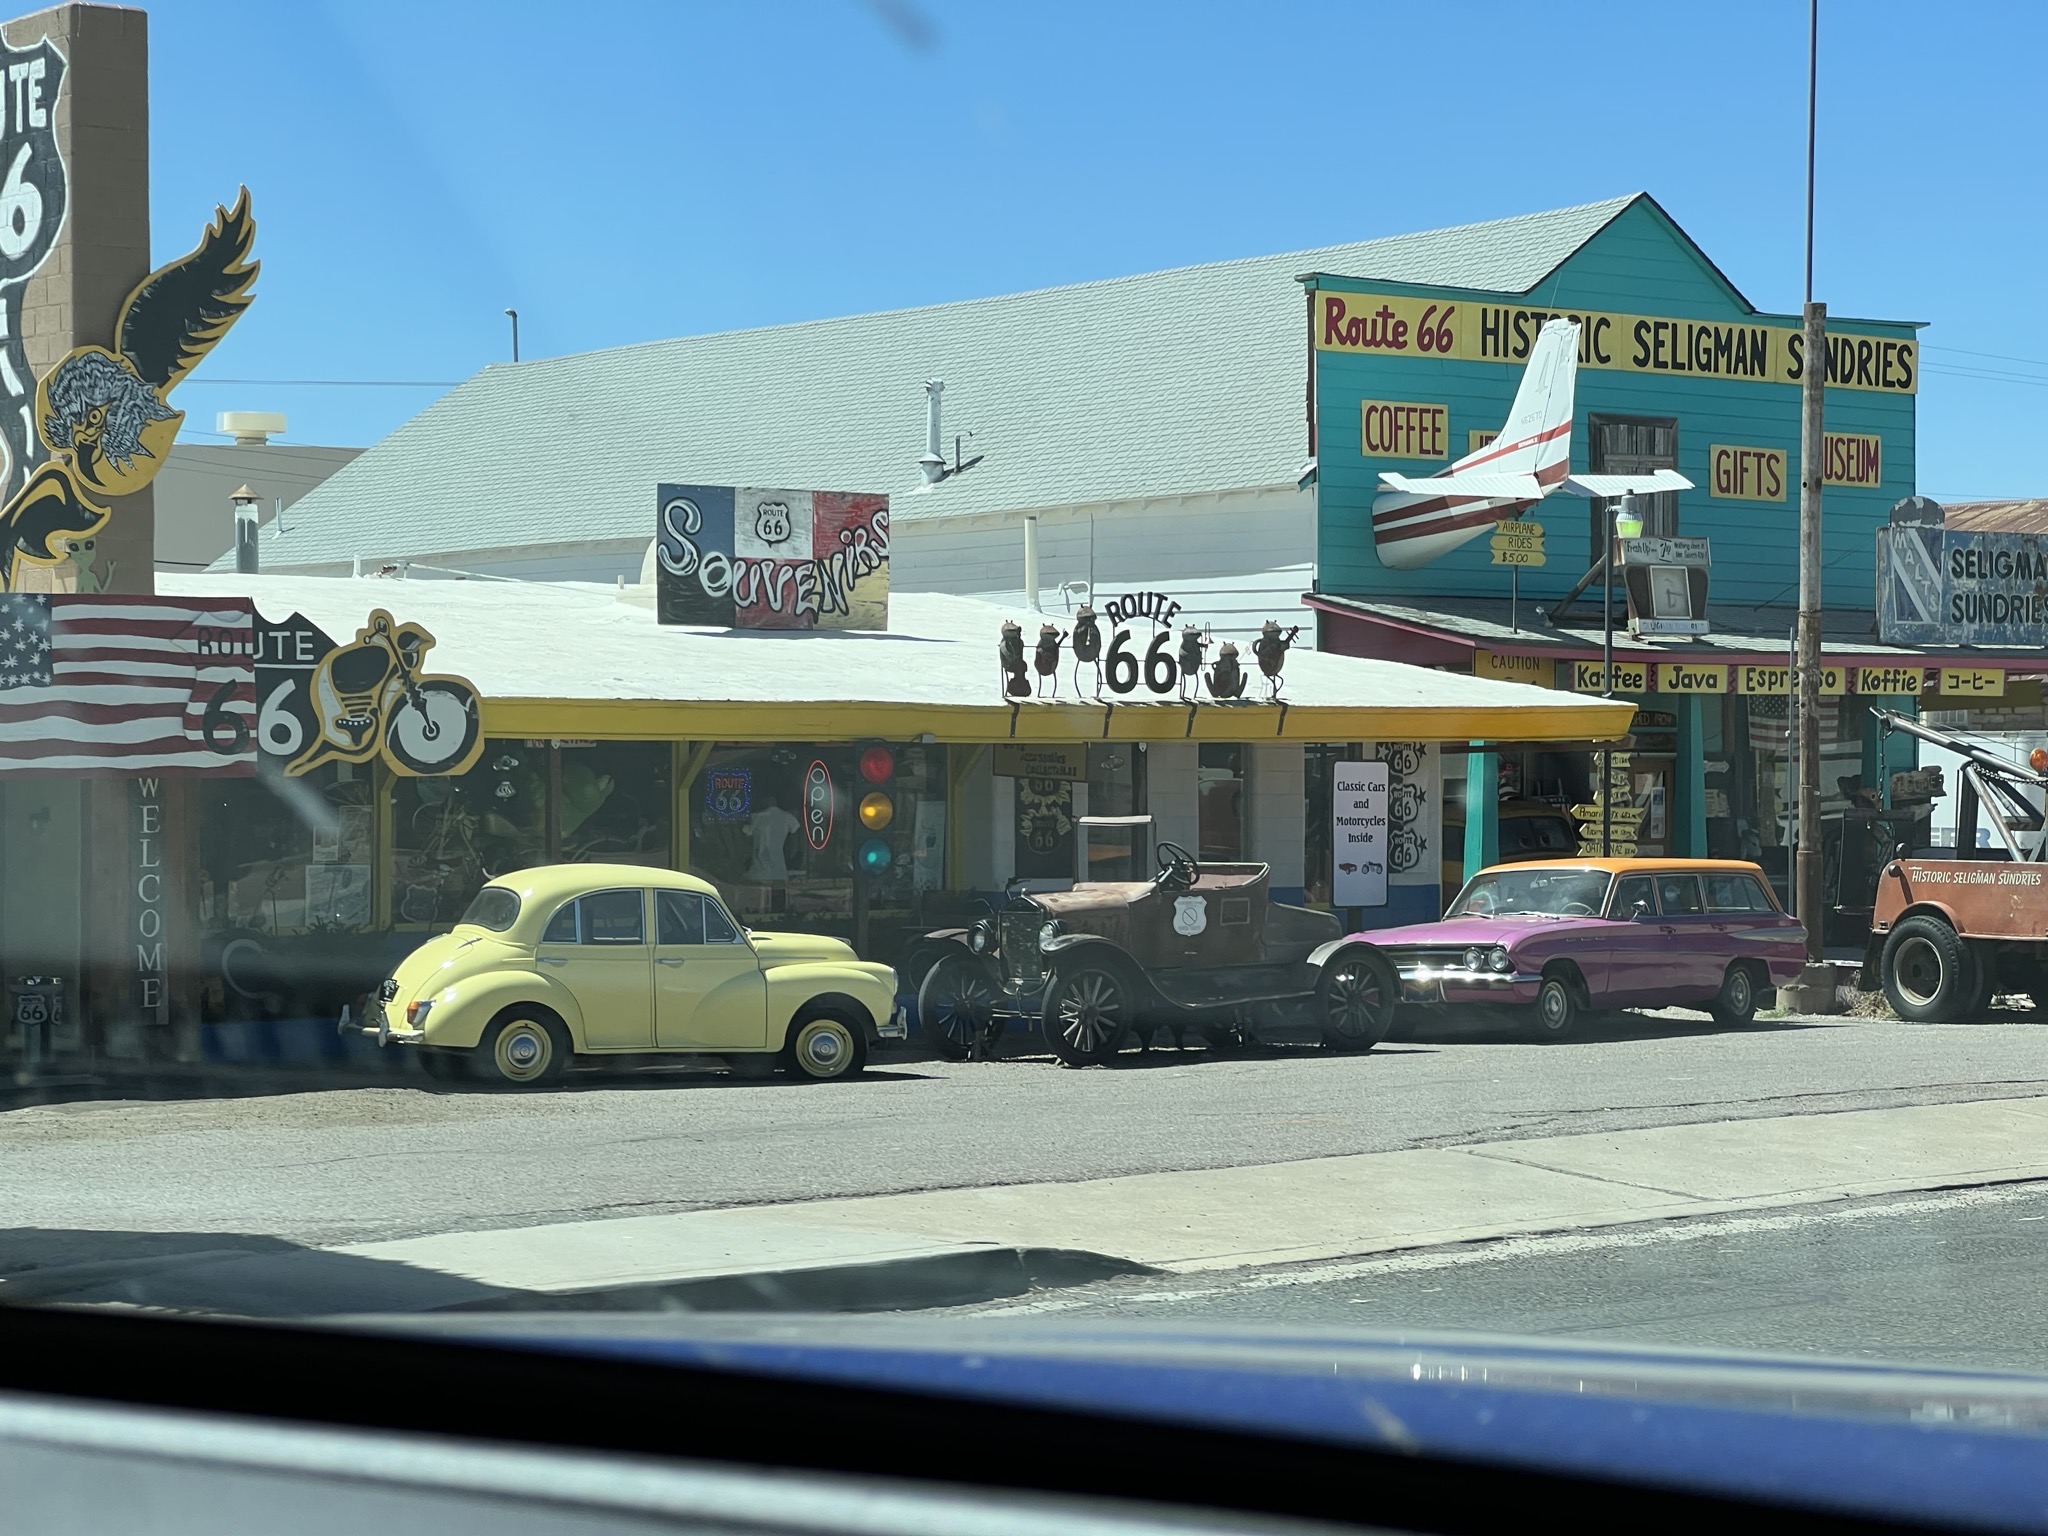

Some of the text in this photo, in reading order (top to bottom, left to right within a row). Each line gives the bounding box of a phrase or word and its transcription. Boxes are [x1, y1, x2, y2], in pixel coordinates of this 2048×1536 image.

[1324, 297, 1409, 350] Route
[1416, 305, 1455, 353] 66
[1632, 319, 1767, 377] SELIGMAN
[1786, 333, 1912, 389] SNDRIES
[1365, 404, 1444, 456] COFFEE
[1822, 436, 1879, 484] USEUM
[1716, 449, 1781, 497] GIFTS
[763, 508, 784, 517] ROUTE
[763, 519, 783, 535] 66
[1502, 521, 1536, 535] AIRPLANE
[1508, 537, 1533, 549] RIDES
[1105, 592, 1181, 629] ROUTE
[197, 627, 315, 661] ROUTE
[1105, 629, 1177, 694] 66
[1491, 655, 1540, 670] CAUTION
[1668, 665, 1718, 689] Java
[1861, 668, 1918, 692] Koffie
[1948, 671, 1996, 691] コーヒー
[202, 678, 304, 756] 66
[1394, 753, 1412, 770] 66
[714, 777, 745, 790] ROUTE
[1337, 781, 1386, 792] Classic Cars
[715, 789, 742, 811] 66
[1393, 790, 1412, 799] ROUTE
[1353, 799, 1369, 809] and
[1394, 800, 1412, 817] 66
[1336, 815, 1386, 828] Motorcycles
[1348, 833, 1373, 843] Inside
[1394, 836, 1413, 845] ROUTE
[1394, 847, 1412, 863] 66
[1911, 870, 2042, 886] HISTORIC SELIGMAN SUNDRIES
[137, 777, 163, 1008] WELCOME
[21, 1005, 43, 1020] 66
